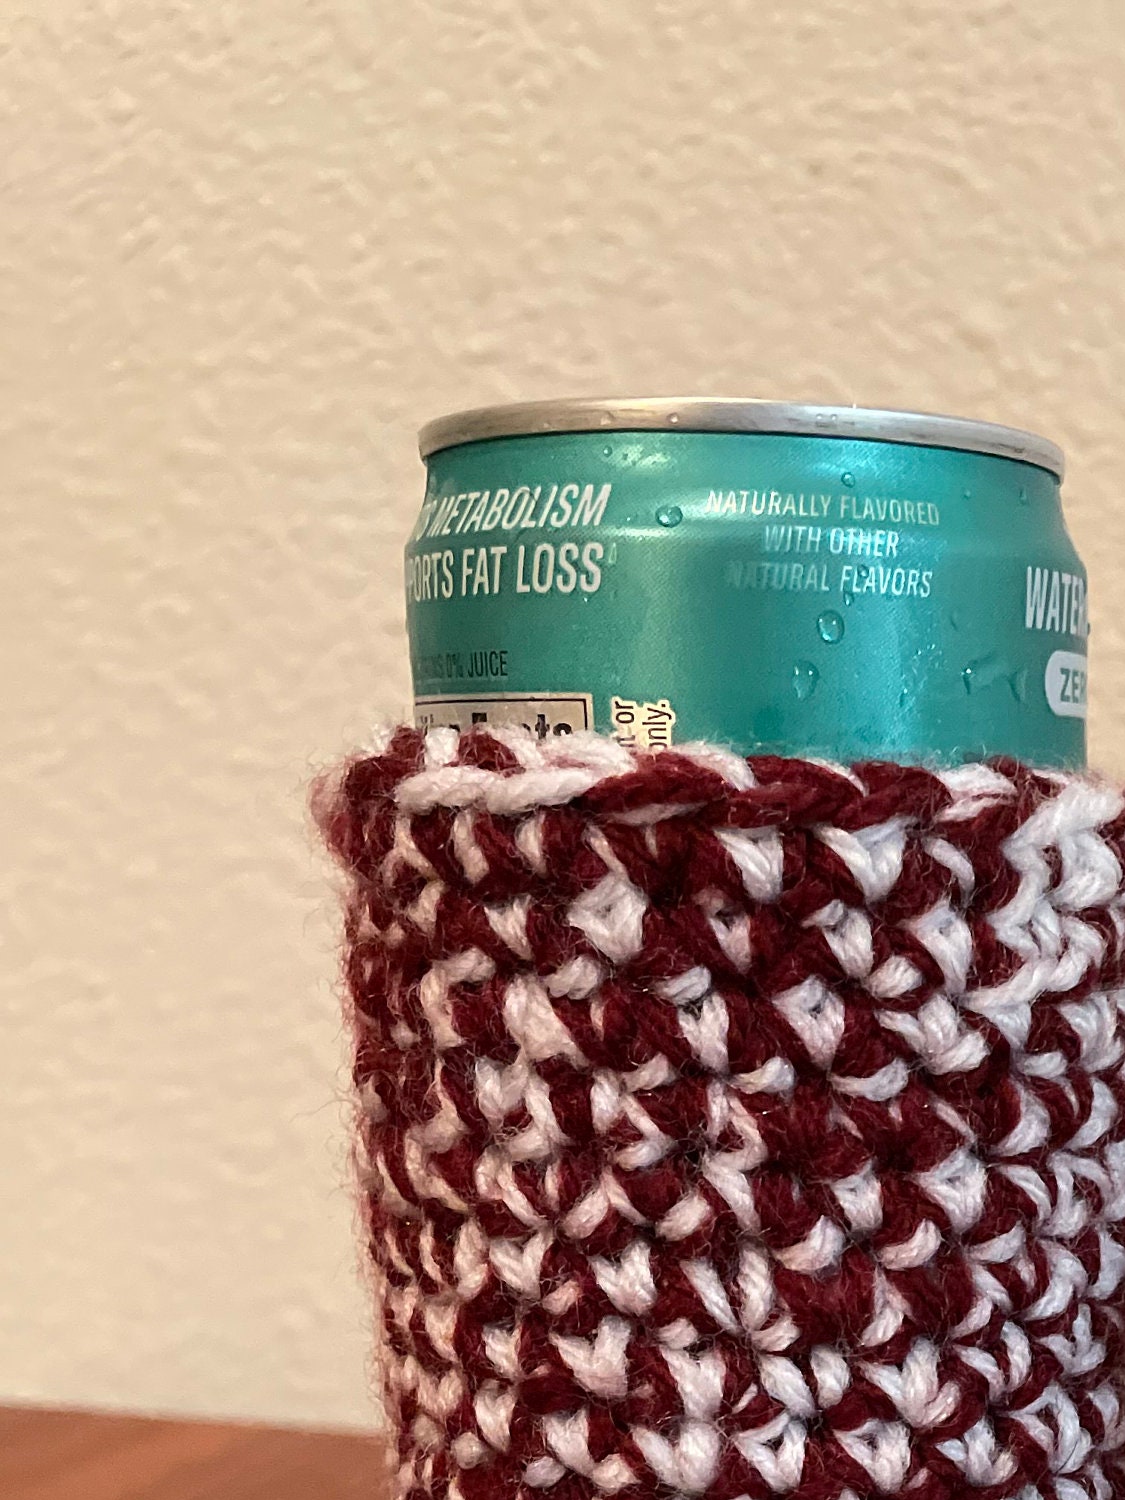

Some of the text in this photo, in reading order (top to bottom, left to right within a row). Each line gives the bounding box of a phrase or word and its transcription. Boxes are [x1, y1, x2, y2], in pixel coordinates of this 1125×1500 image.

[426, 483, 612, 537] METABOLISM
[704, 490, 940, 526] NATURALLY FLAVORED
[764, 525, 900, 557] WITH OTHER
[461, 546, 508, 597] FAT
[515, 543, 604, 594] LOSS
[727, 560, 933, 598] NATURAL FLAVORS
[467, 650, 509, 678] JUICE
